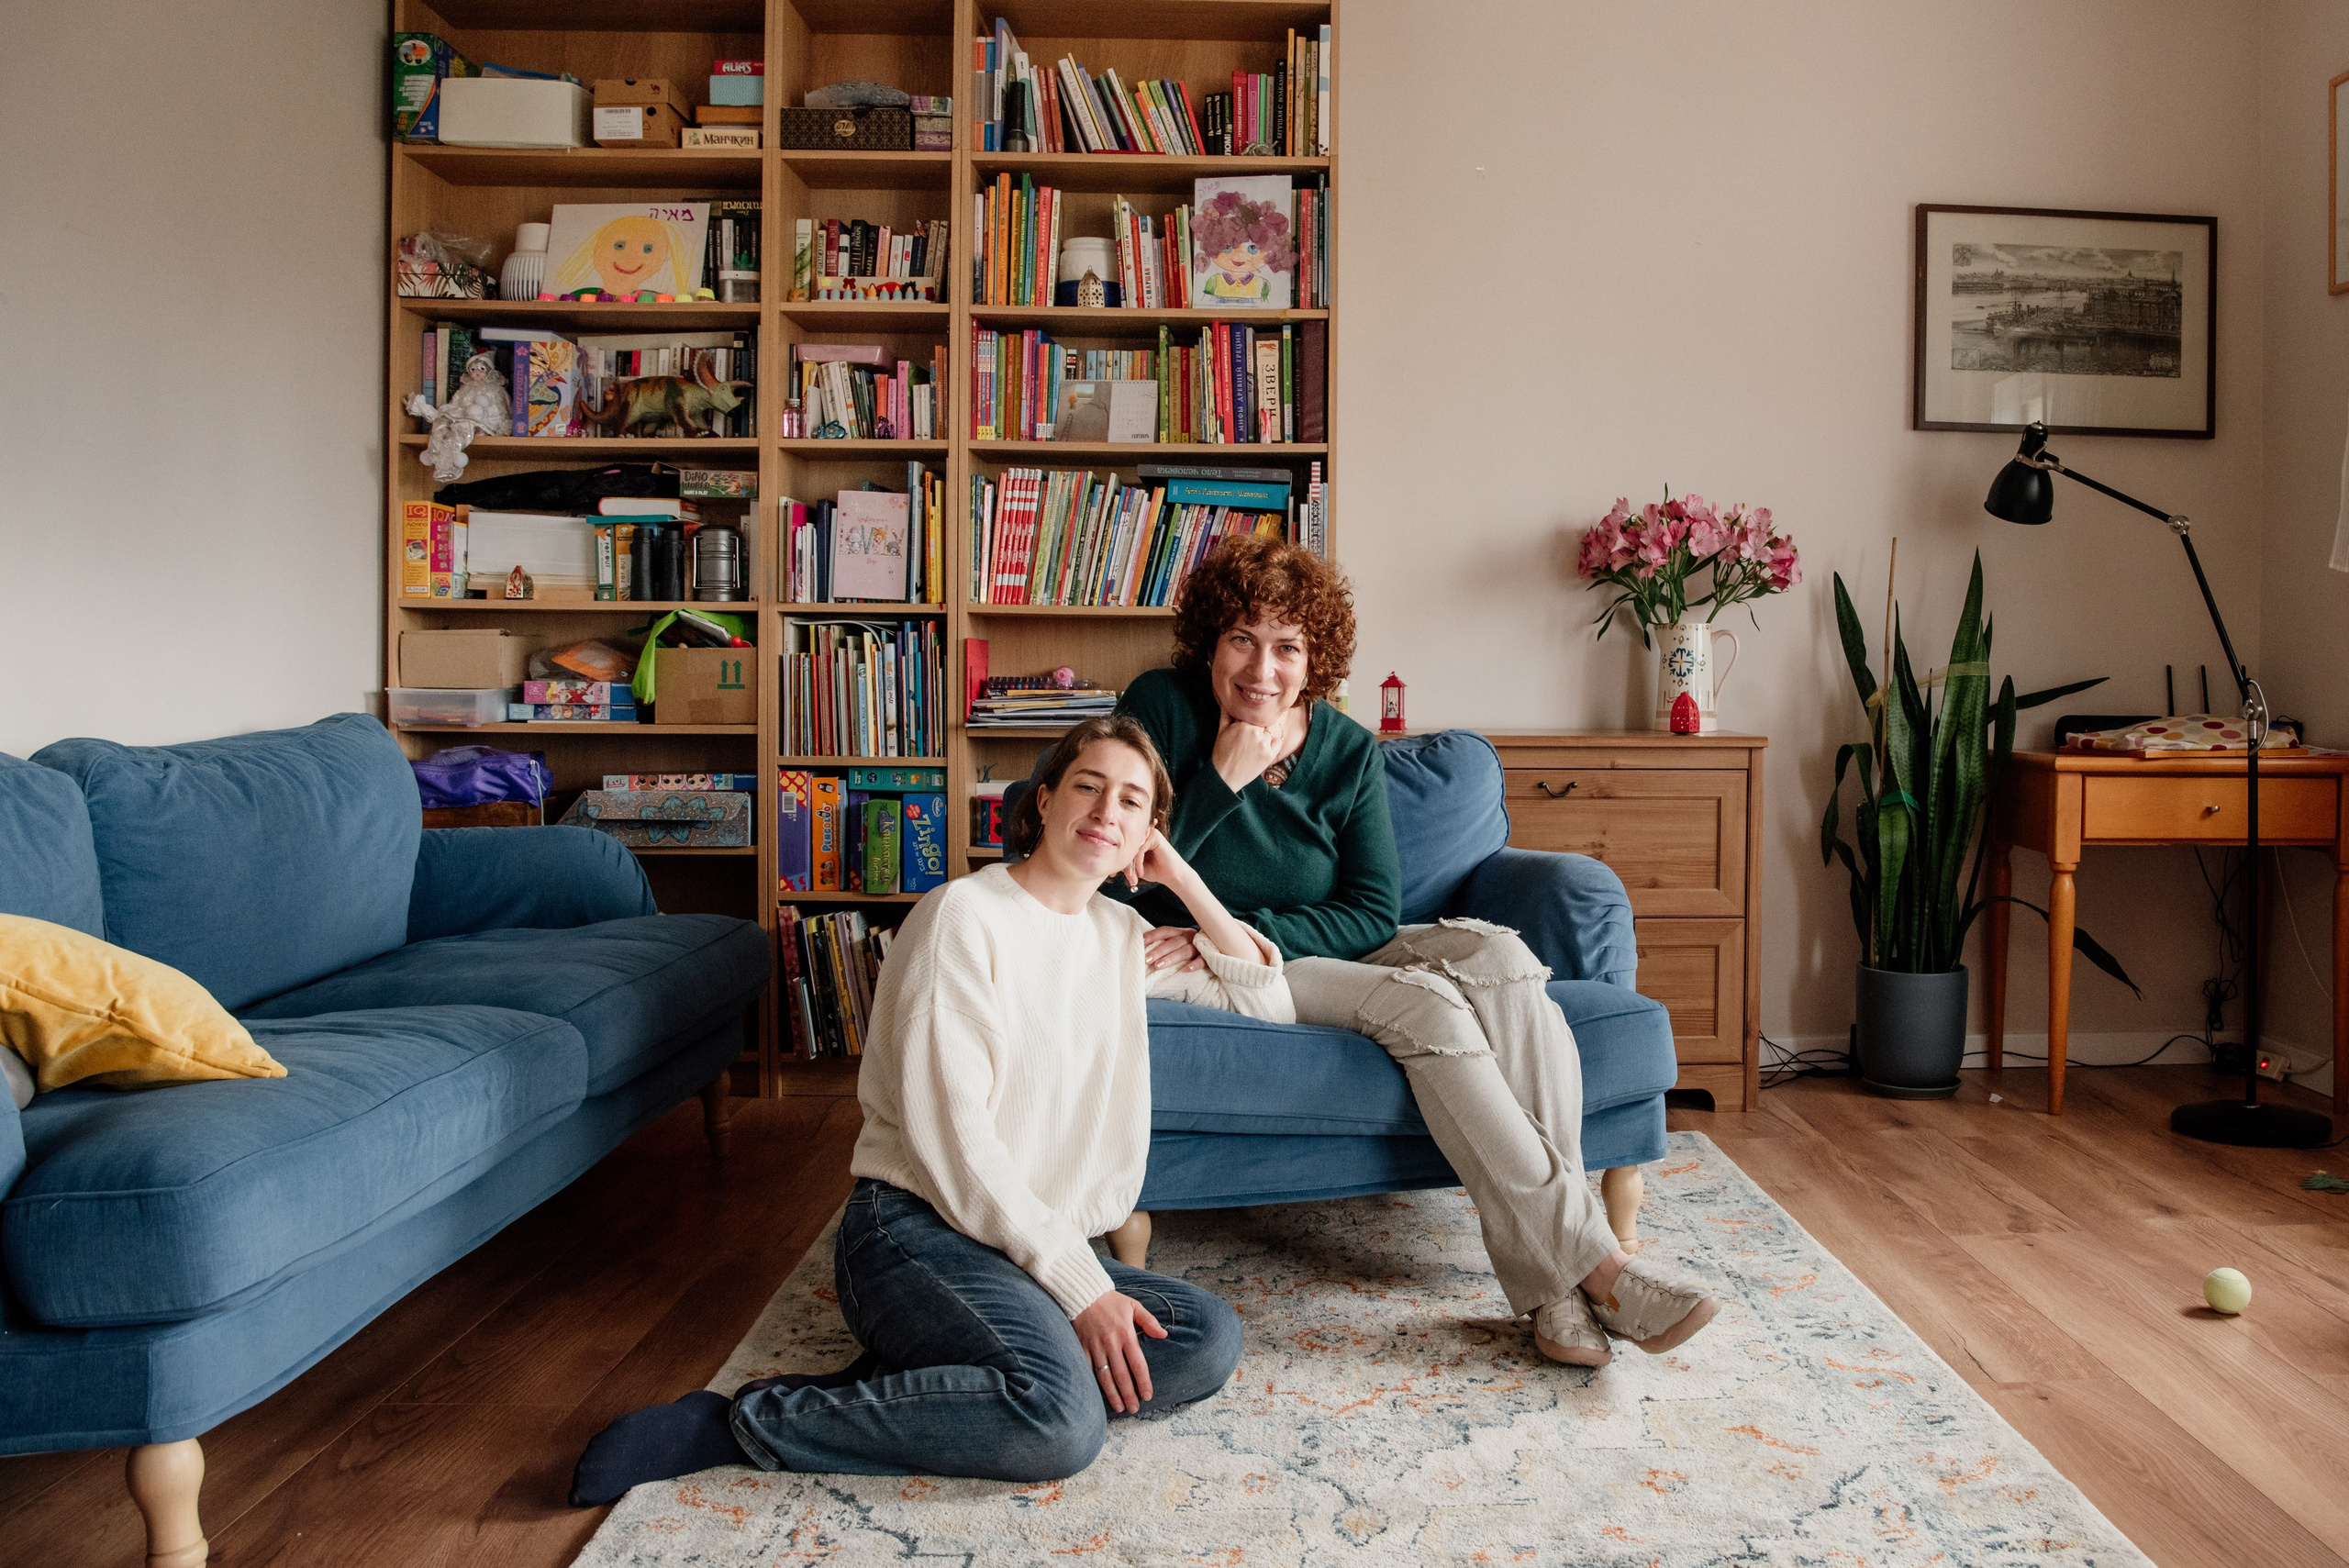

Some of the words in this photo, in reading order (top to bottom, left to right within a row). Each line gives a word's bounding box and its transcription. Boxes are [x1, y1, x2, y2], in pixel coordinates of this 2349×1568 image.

[704, 133, 754, 148] Манчкин
[650, 207, 695, 222] מאיה
[1144, 268, 1152, 295] МАРШАК
[1235, 366, 1243, 402] ДРЕВНЕЙ
[1265, 364, 1277, 417] ЗВЕРИ
[1157, 467, 1198, 475] человека
[1201, 469, 1222, 478] Тело
[407, 506, 428, 517] IQ
[433, 509, 444, 521] IQ
[911, 814, 944, 876] Zingo!
